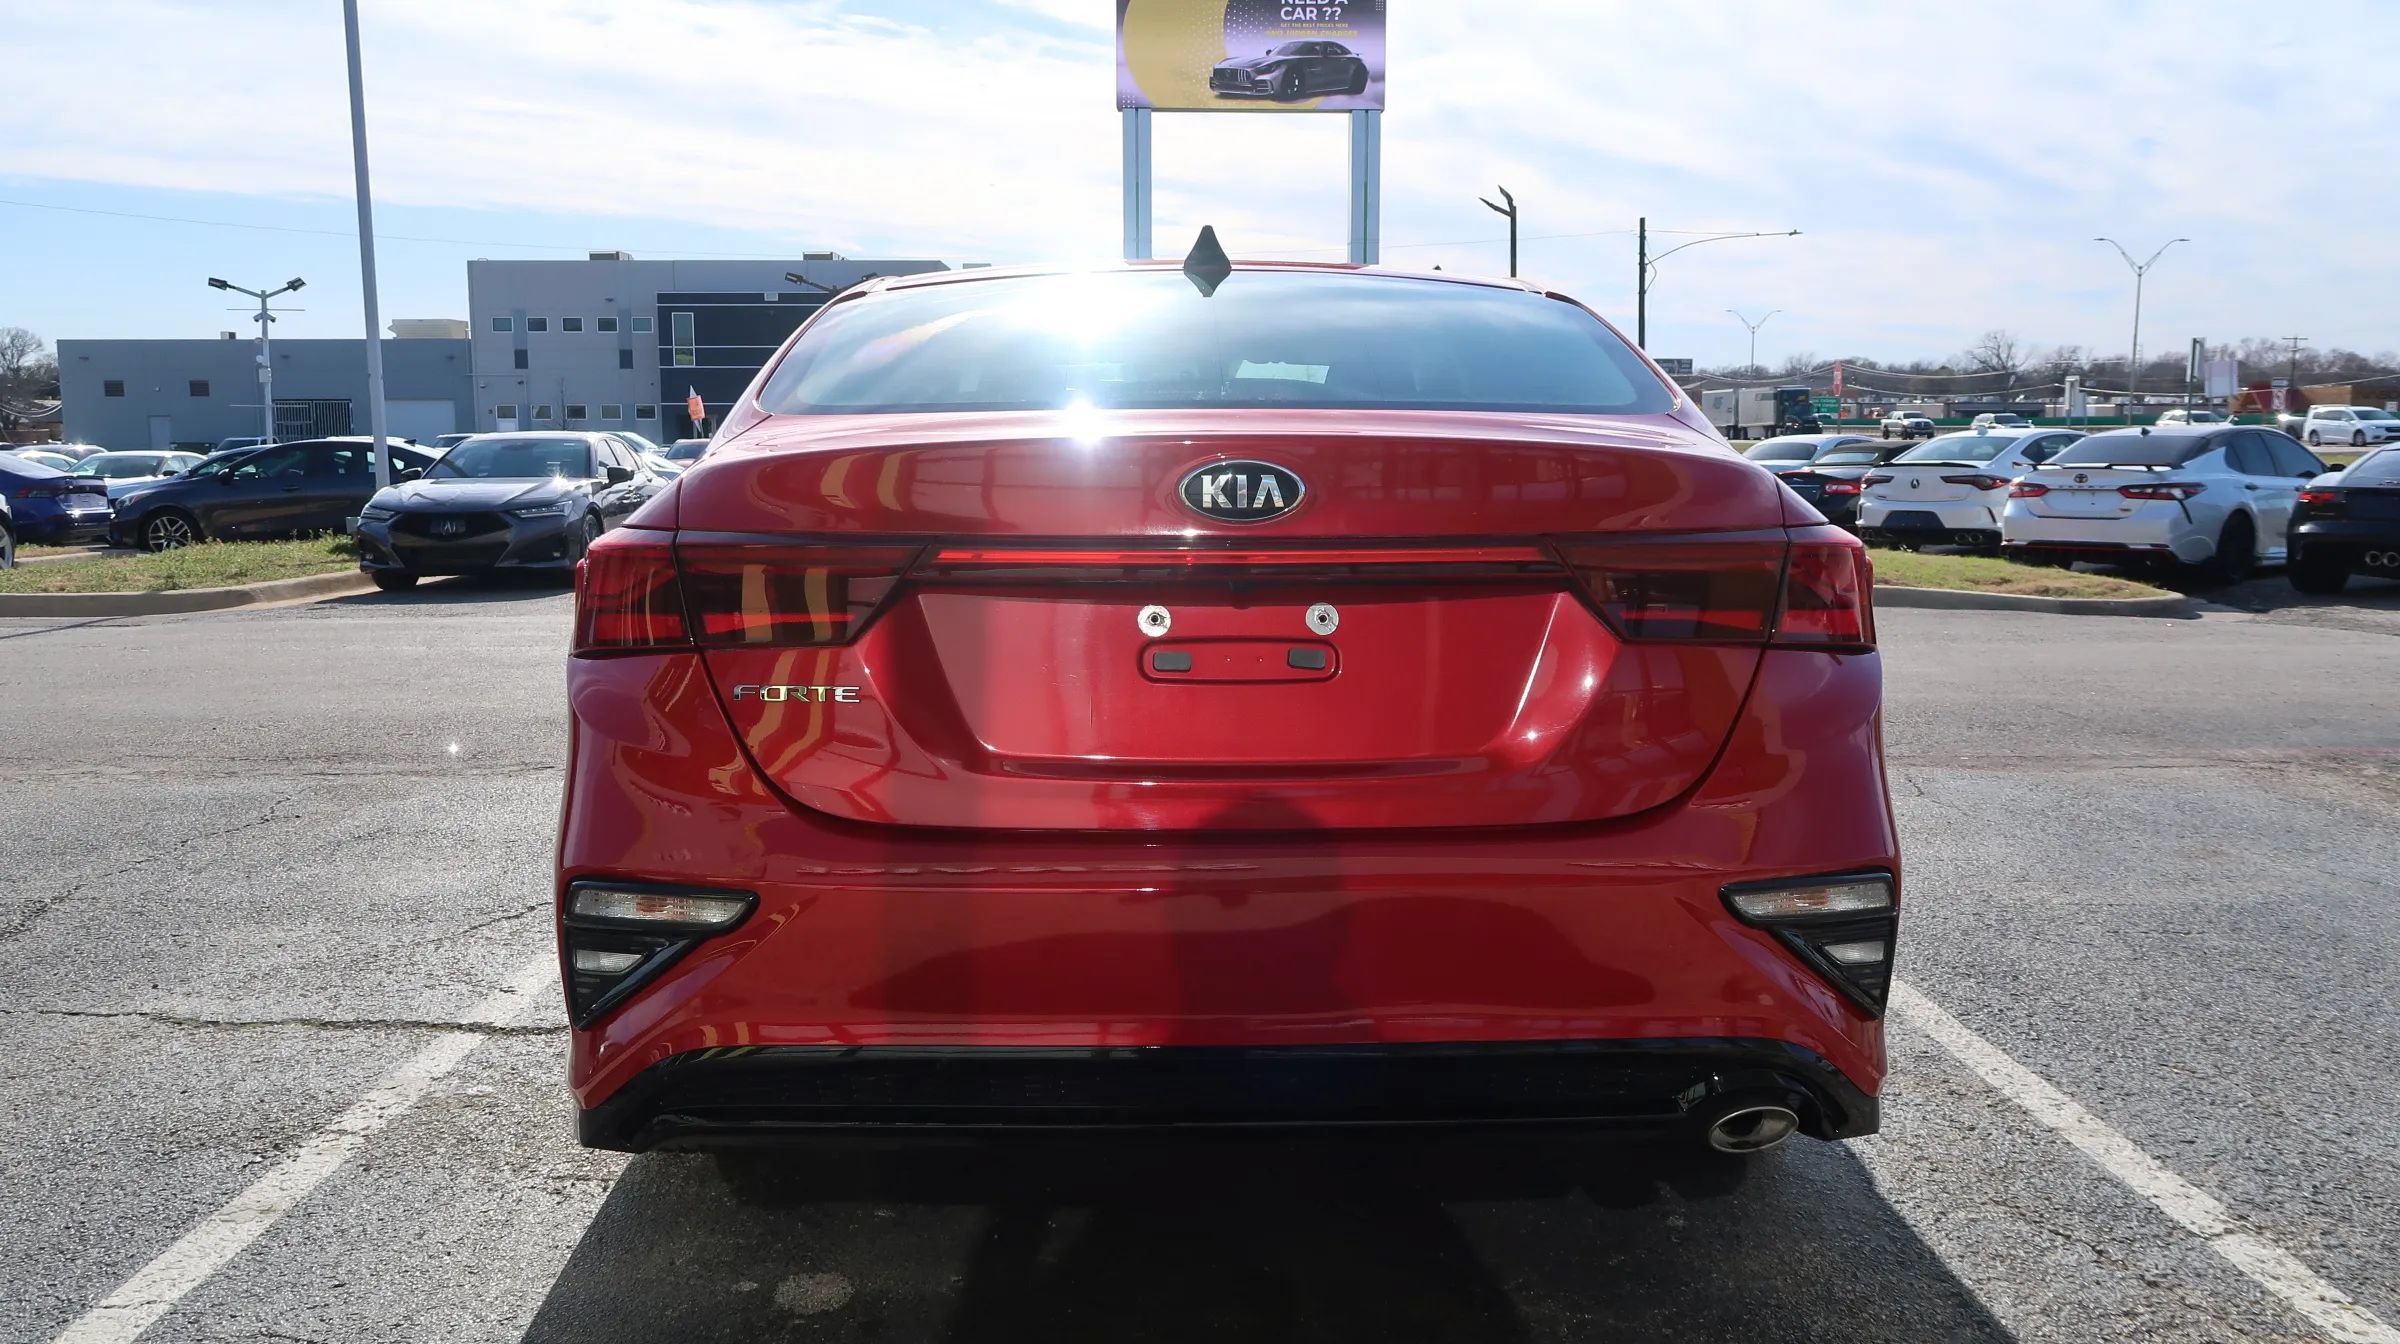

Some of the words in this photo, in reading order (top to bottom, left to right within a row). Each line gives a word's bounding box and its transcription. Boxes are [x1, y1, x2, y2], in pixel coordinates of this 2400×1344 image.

[1280, 7, 1317, 20] CAR
[1322, 7, 1341, 20] ??
[1201, 474, 1285, 508] KIA
[733, 685, 860, 702] FORTE
